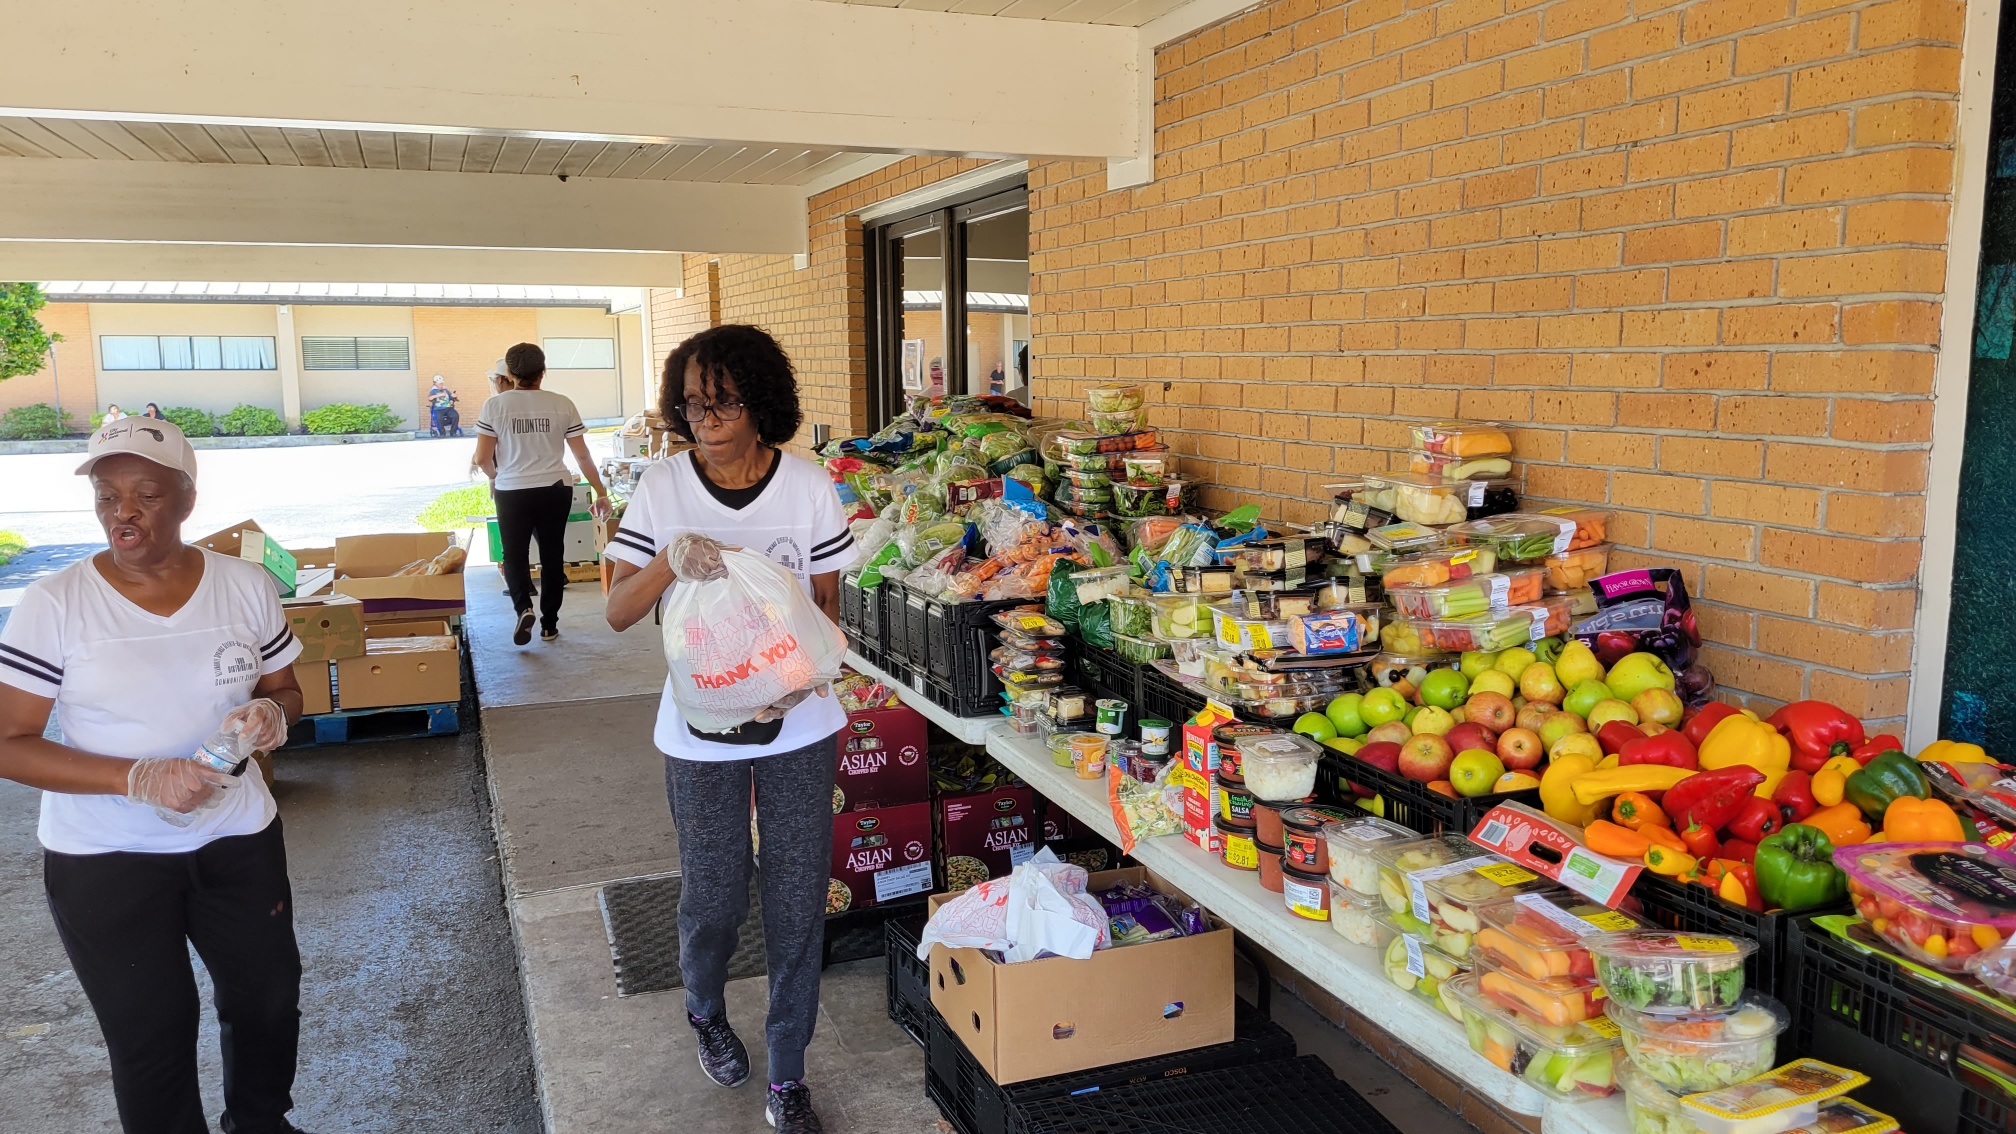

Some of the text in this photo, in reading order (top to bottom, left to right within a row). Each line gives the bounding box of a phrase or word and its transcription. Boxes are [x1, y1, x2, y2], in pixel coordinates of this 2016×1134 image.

[511, 418, 550, 434] VOLUNTEER
[1605, 581, 1628, 593] FLAVOR
[691, 633, 798, 689] THANK YOU
[839, 751, 887, 771] ASIAN
[1231, 805, 1250, 814] SALSA
[983, 827, 1028, 848] ASIAN
[845, 847, 892, 869] ASIAN
[1232, 852, 1249, 866] $2.81
[1956, 860, 1997, 877] PETITE
